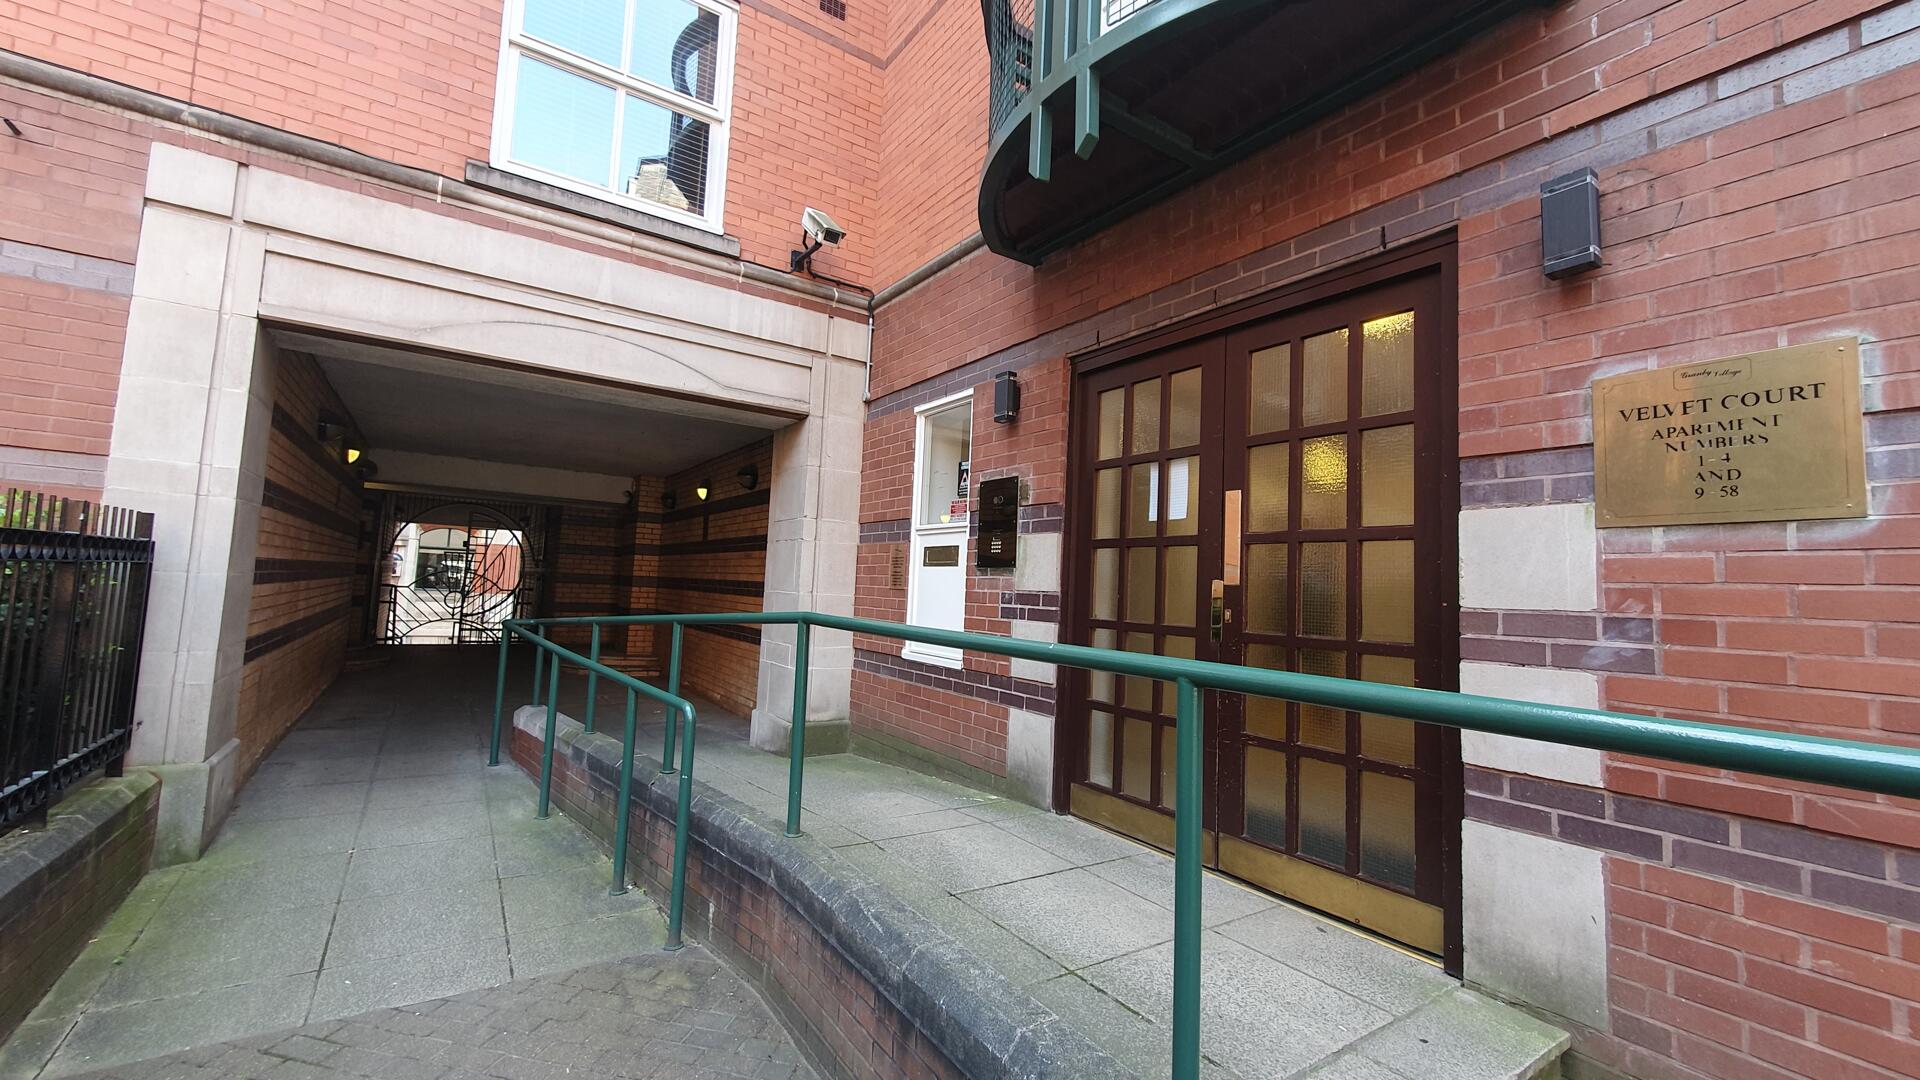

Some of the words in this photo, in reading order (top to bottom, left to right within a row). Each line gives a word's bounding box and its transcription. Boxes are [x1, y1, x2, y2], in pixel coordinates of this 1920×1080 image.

[1619, 398, 1713, 423] VELVET
[1721, 382, 1826, 409] COURT
[1651, 413, 1784, 440] APARTMENT
[1666, 434, 1769, 453] NUMBERS
[1695, 468, 1742, 482] AND
